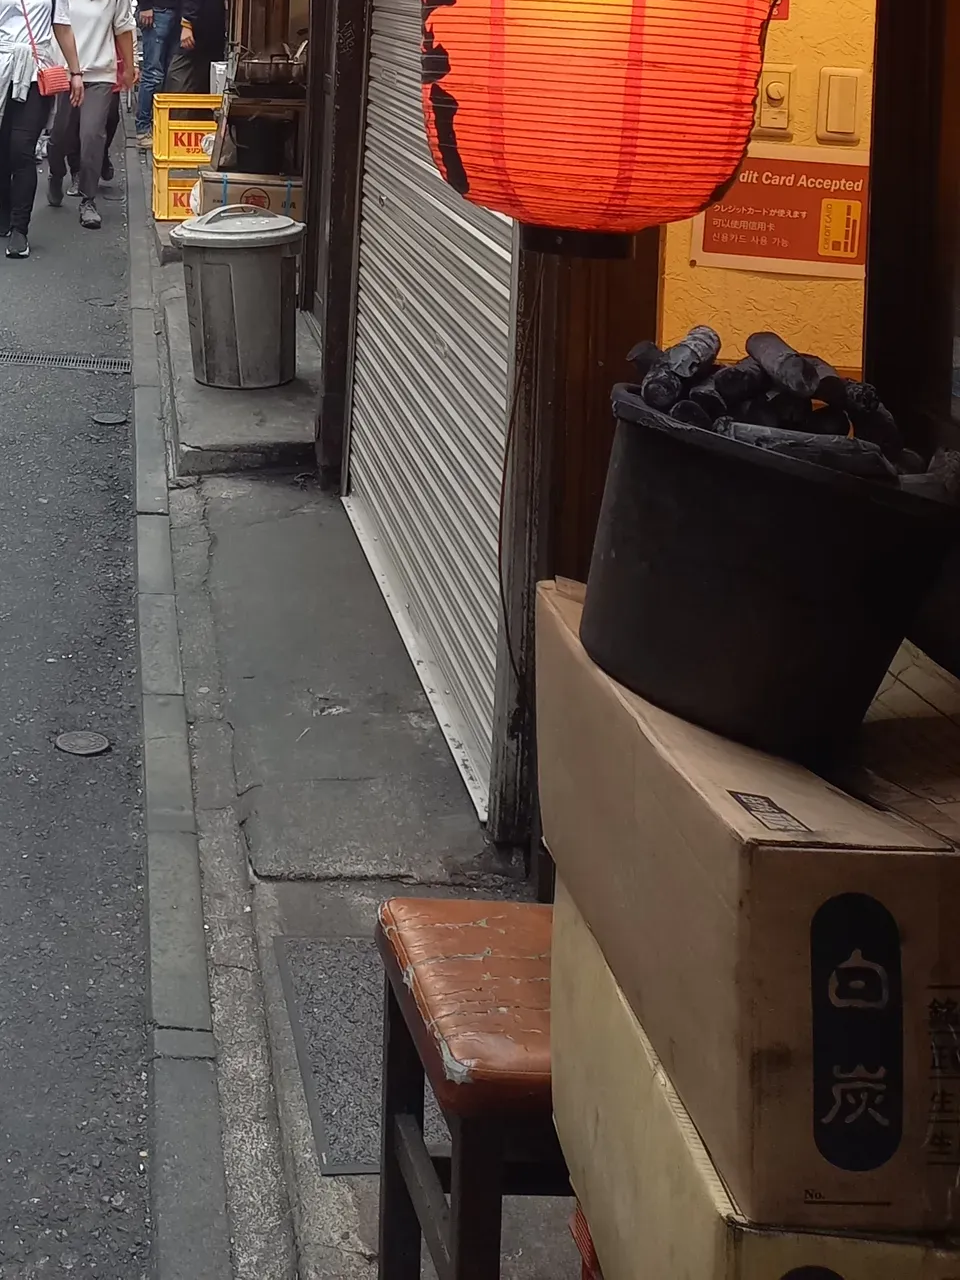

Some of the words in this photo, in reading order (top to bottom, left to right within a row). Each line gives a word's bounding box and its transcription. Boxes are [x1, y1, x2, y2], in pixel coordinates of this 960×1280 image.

[174, 131, 208, 147] KIR
[739, 170, 758, 184] dit
[761, 171, 795, 187] Card
[797, 174, 863, 192] Accepted
[713, 204, 808, 219] クレジットカードが使えます
[712, 218, 775, 232] 可以使用信用卡
[712, 232, 747, 243] 신용카드
[750, 235, 768, 246] 사용
[771, 237, 789, 248] 가능
[820, 948, 889, 1125] 白炭
[803, 1189, 826, 1200] No.
